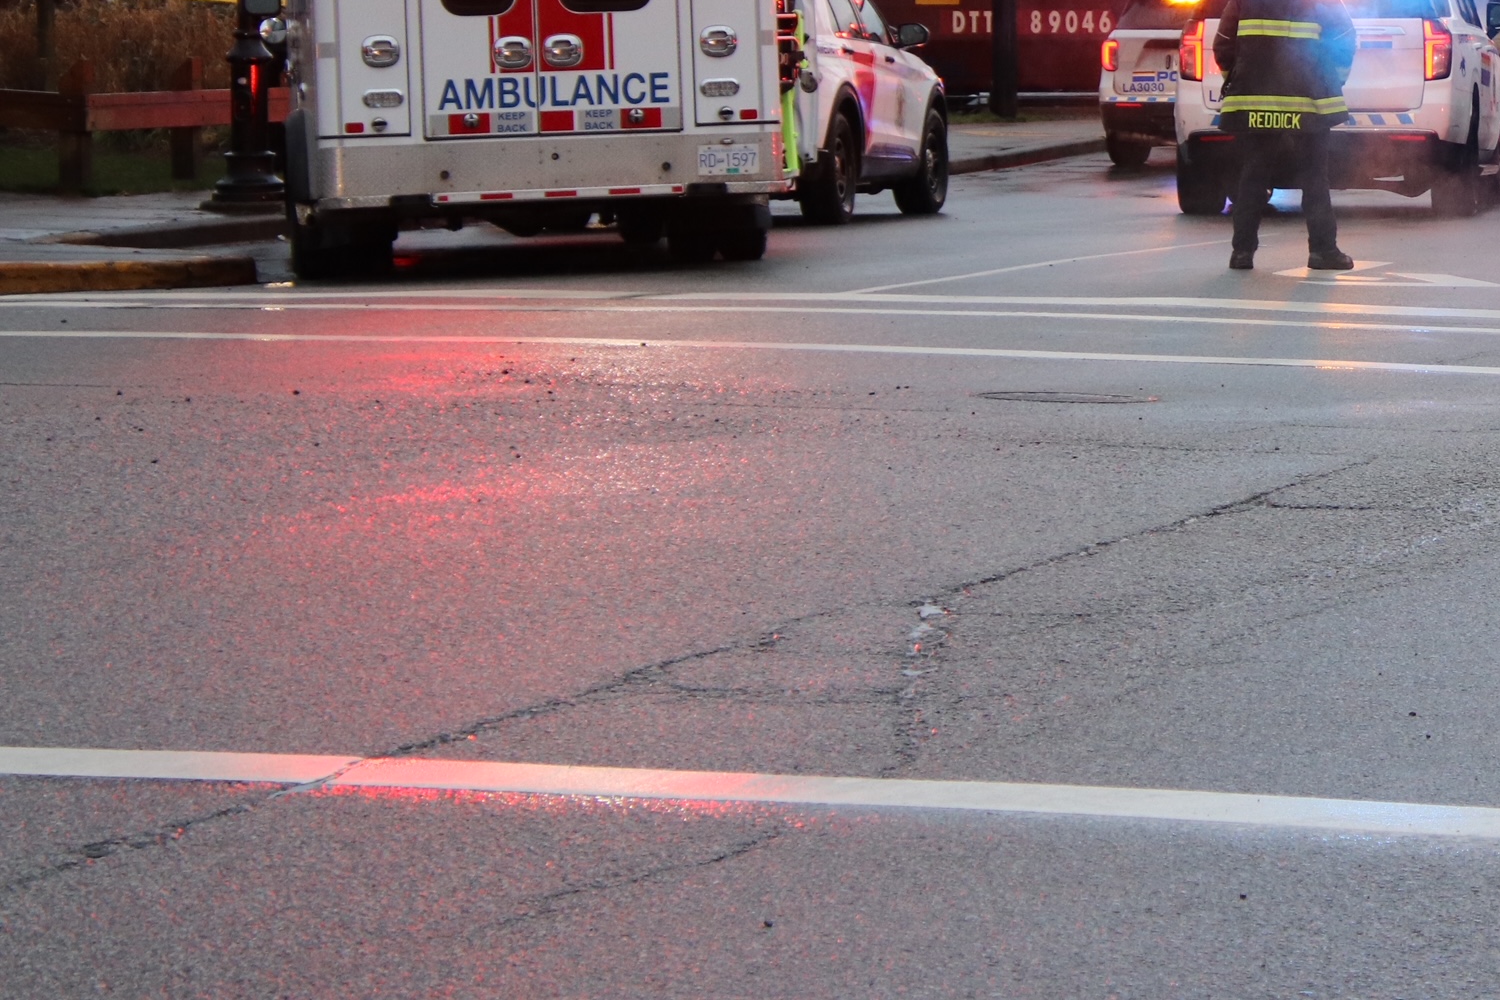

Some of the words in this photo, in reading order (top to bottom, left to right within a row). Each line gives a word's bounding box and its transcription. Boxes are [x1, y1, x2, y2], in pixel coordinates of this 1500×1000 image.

[1030, 10, 1112, 33] 89046
[438, 72, 670, 111] AMBULANCE
[1122, 82, 1165, 93] LA3030
[498, 111, 525, 120] KEEP
[585, 109, 613, 118] KEEP
[1248, 111, 1301, 129] REDDICK
[497, 124, 527, 133] BACK
[584, 121, 614, 130] BACK
